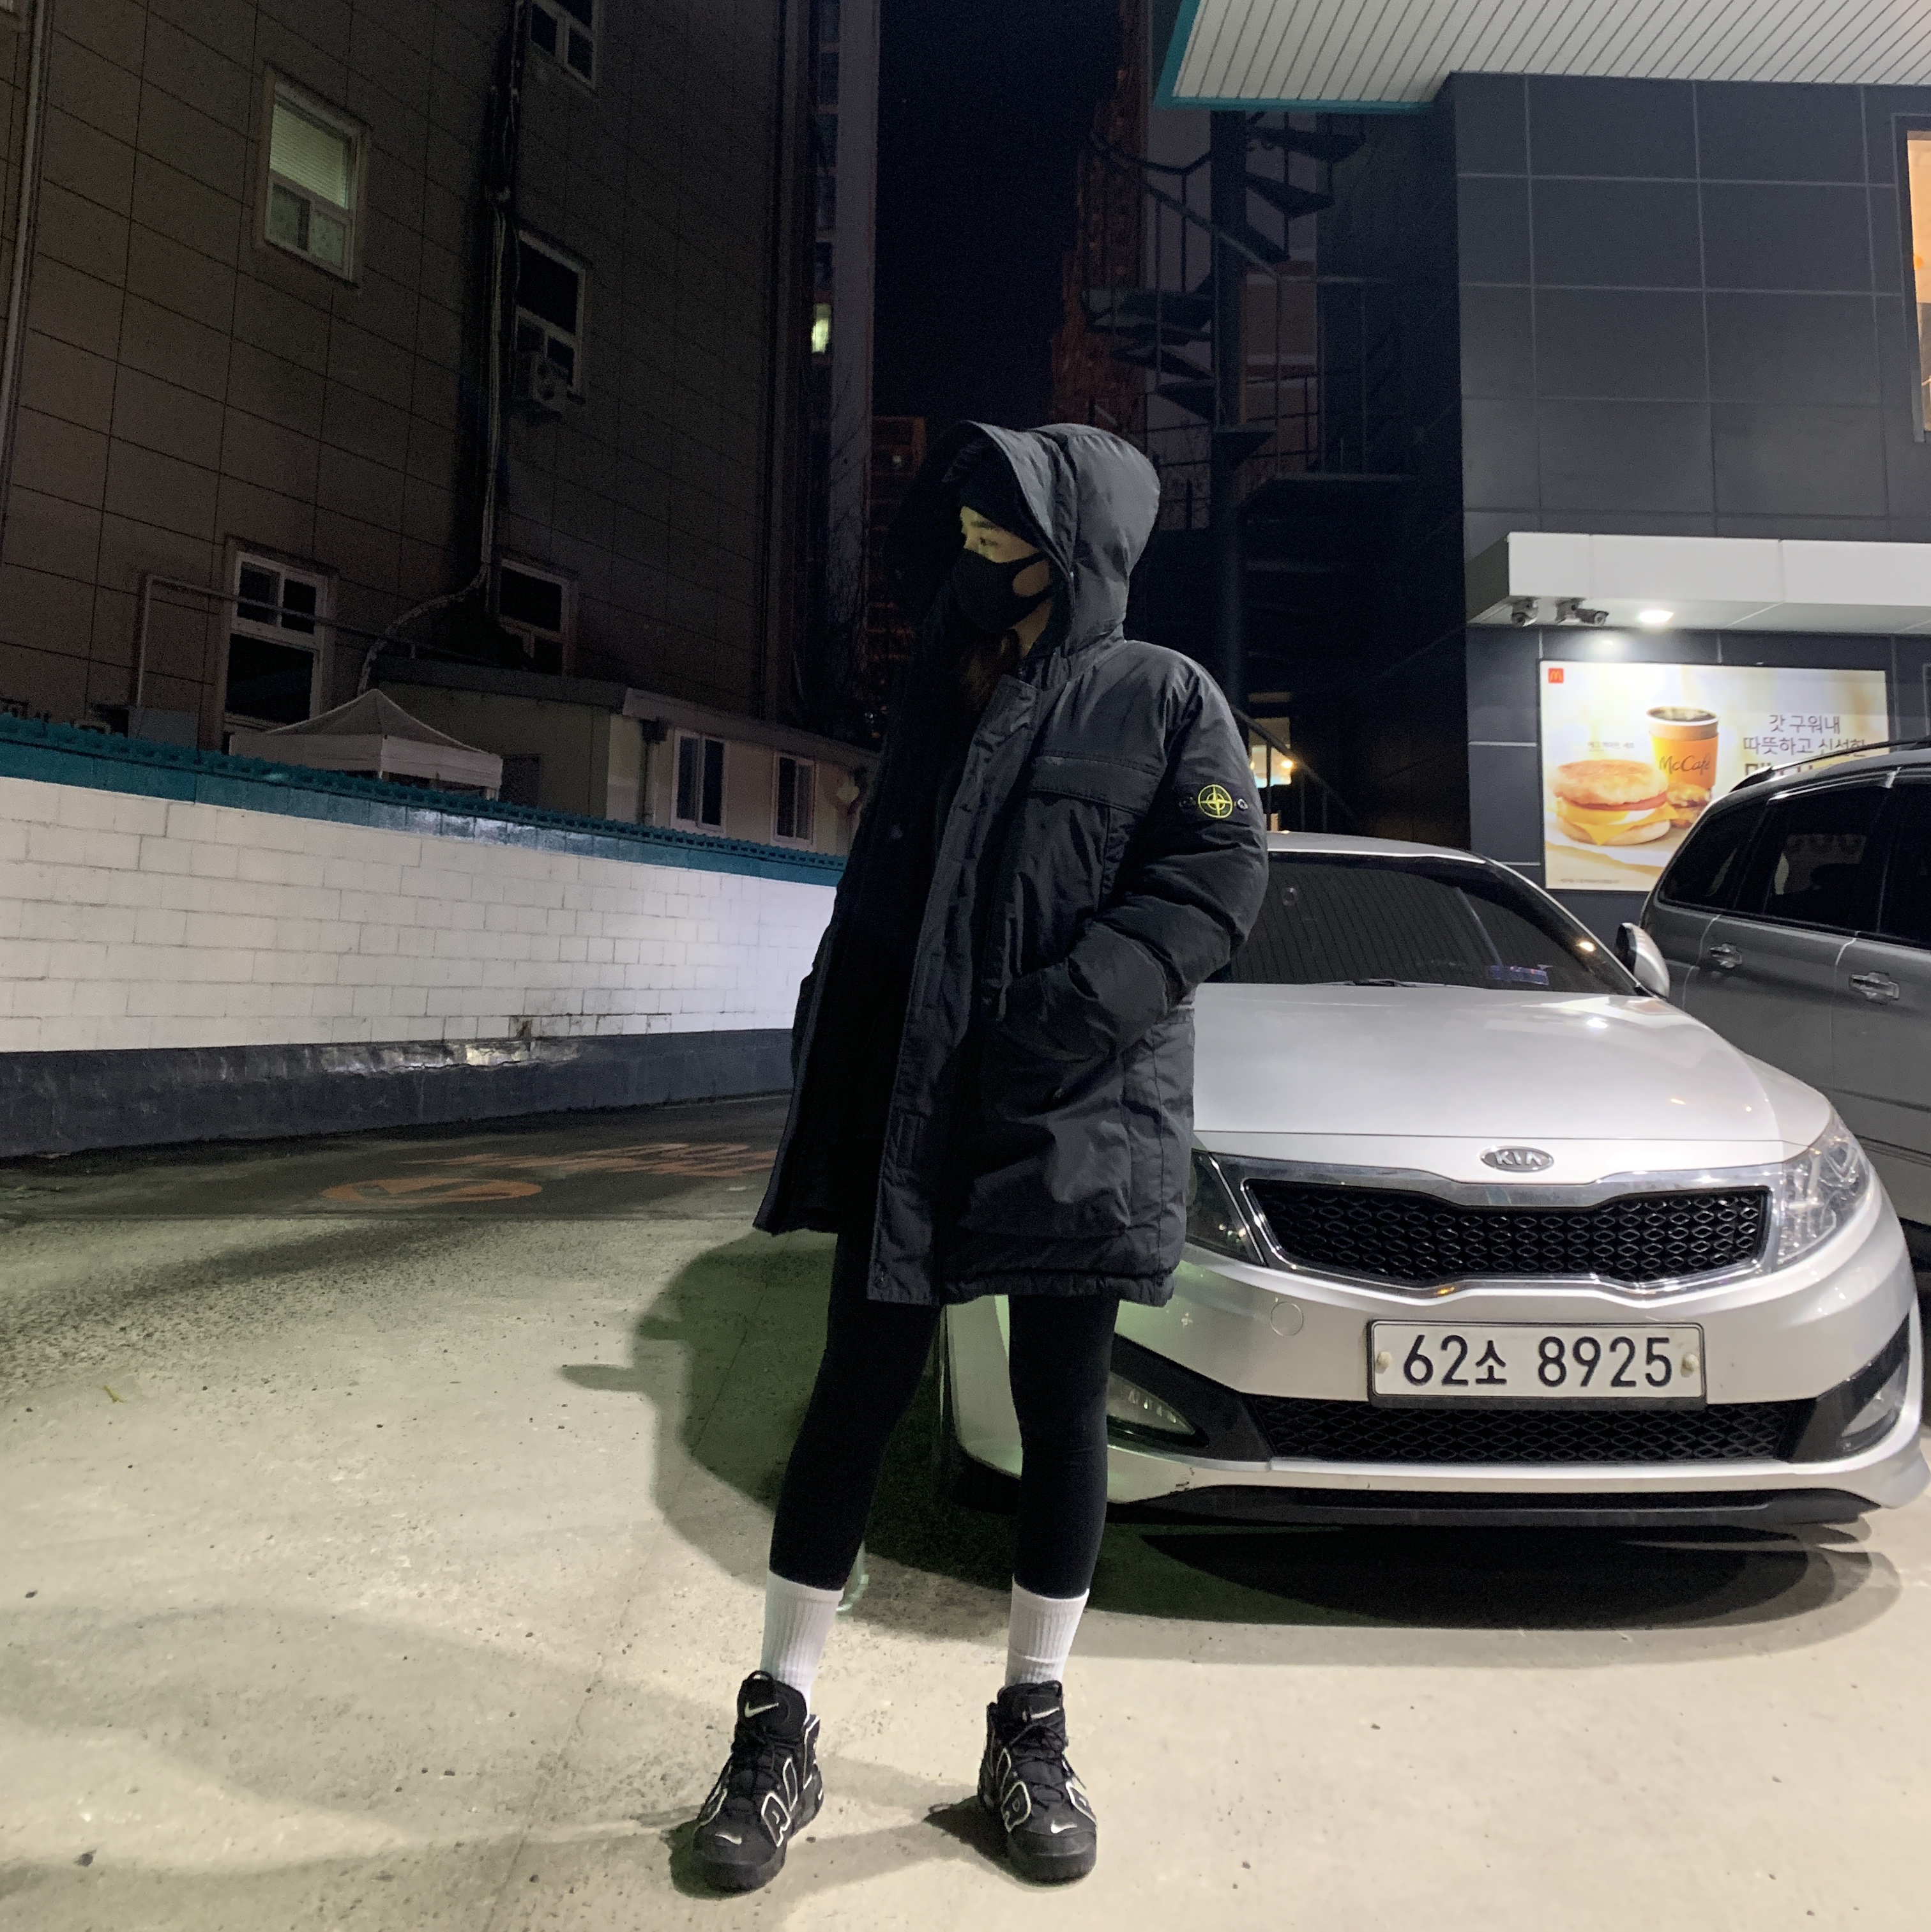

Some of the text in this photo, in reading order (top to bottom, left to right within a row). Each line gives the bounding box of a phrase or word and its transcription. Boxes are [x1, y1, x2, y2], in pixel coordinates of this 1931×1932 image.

[1769, 714, 1841, 734] 갓 구워내
[1743, 736, 1814, 756] 따뜻하고
[1494, 1150, 1542, 1166] KIA
[1404, 1334, 1673, 1388] 62소 8925
